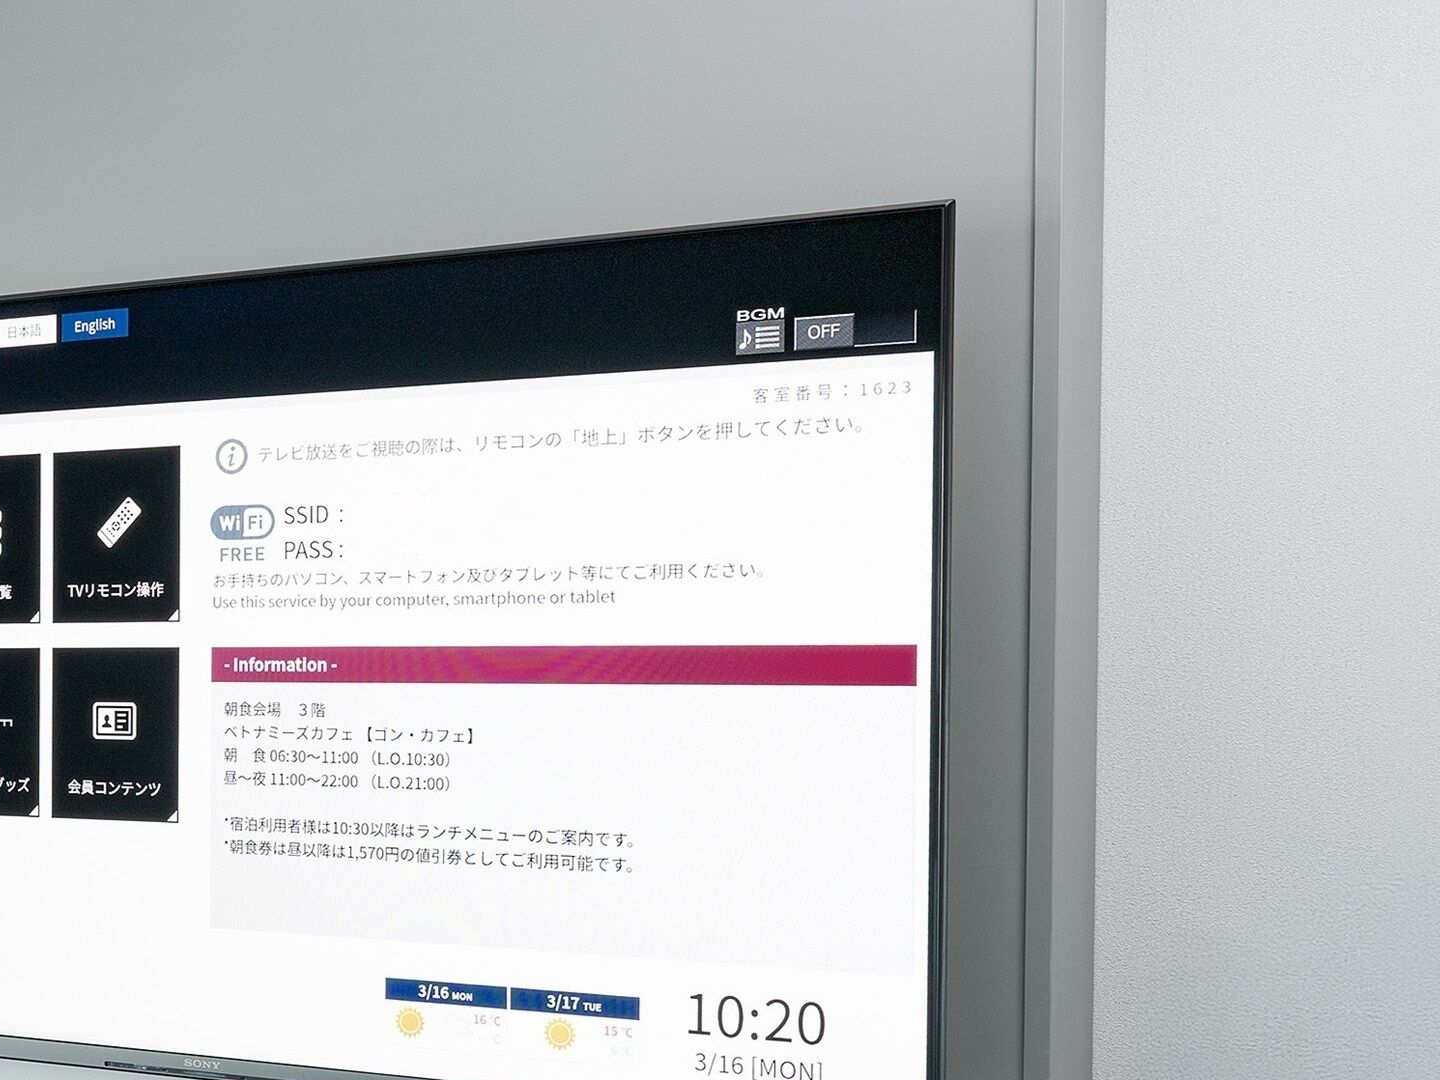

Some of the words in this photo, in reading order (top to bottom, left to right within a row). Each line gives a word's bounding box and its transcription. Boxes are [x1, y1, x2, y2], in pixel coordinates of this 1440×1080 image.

[735, 305, 786, 322] BGM
[5, 321, 43, 341] 日本語
[74, 316, 116, 333] English
[806, 322, 841, 340] OFF
[284, 505, 328, 524] SSID
[220, 547, 264, 562] FREE
[67, 581, 164, 598] TVリモコン操作
[213, 597, 237, 609] Use
[241, 595, 265, 608] this
[269, 594, 316, 608] service
[320, 594, 336, 610] by
[340, 597, 372, 611] your
[375, 593, 450, 610] computer,
[453, 590, 546, 608] smartphone
[549, 593, 566, 605] or
[571, 590, 615, 603] tablet
[234, 657, 327, 673] Information
[225, 701, 280, 717] 朝食会場
[225, 726, 352, 740] ベトナミーズカフェ
[68, 779, 161, 796] 会員コンテンツ
[418, 984, 449, 1000] 3/16
[452, 992, 473, 1002] MON
[546, 994, 580, 1011] 3/17
[582, 1002, 602, 1012] TUE
[688, 994, 825, 1045] 10:20
[184, 1058, 221, 1070] SONY
[695, 1053, 743, 1076] 3/16
